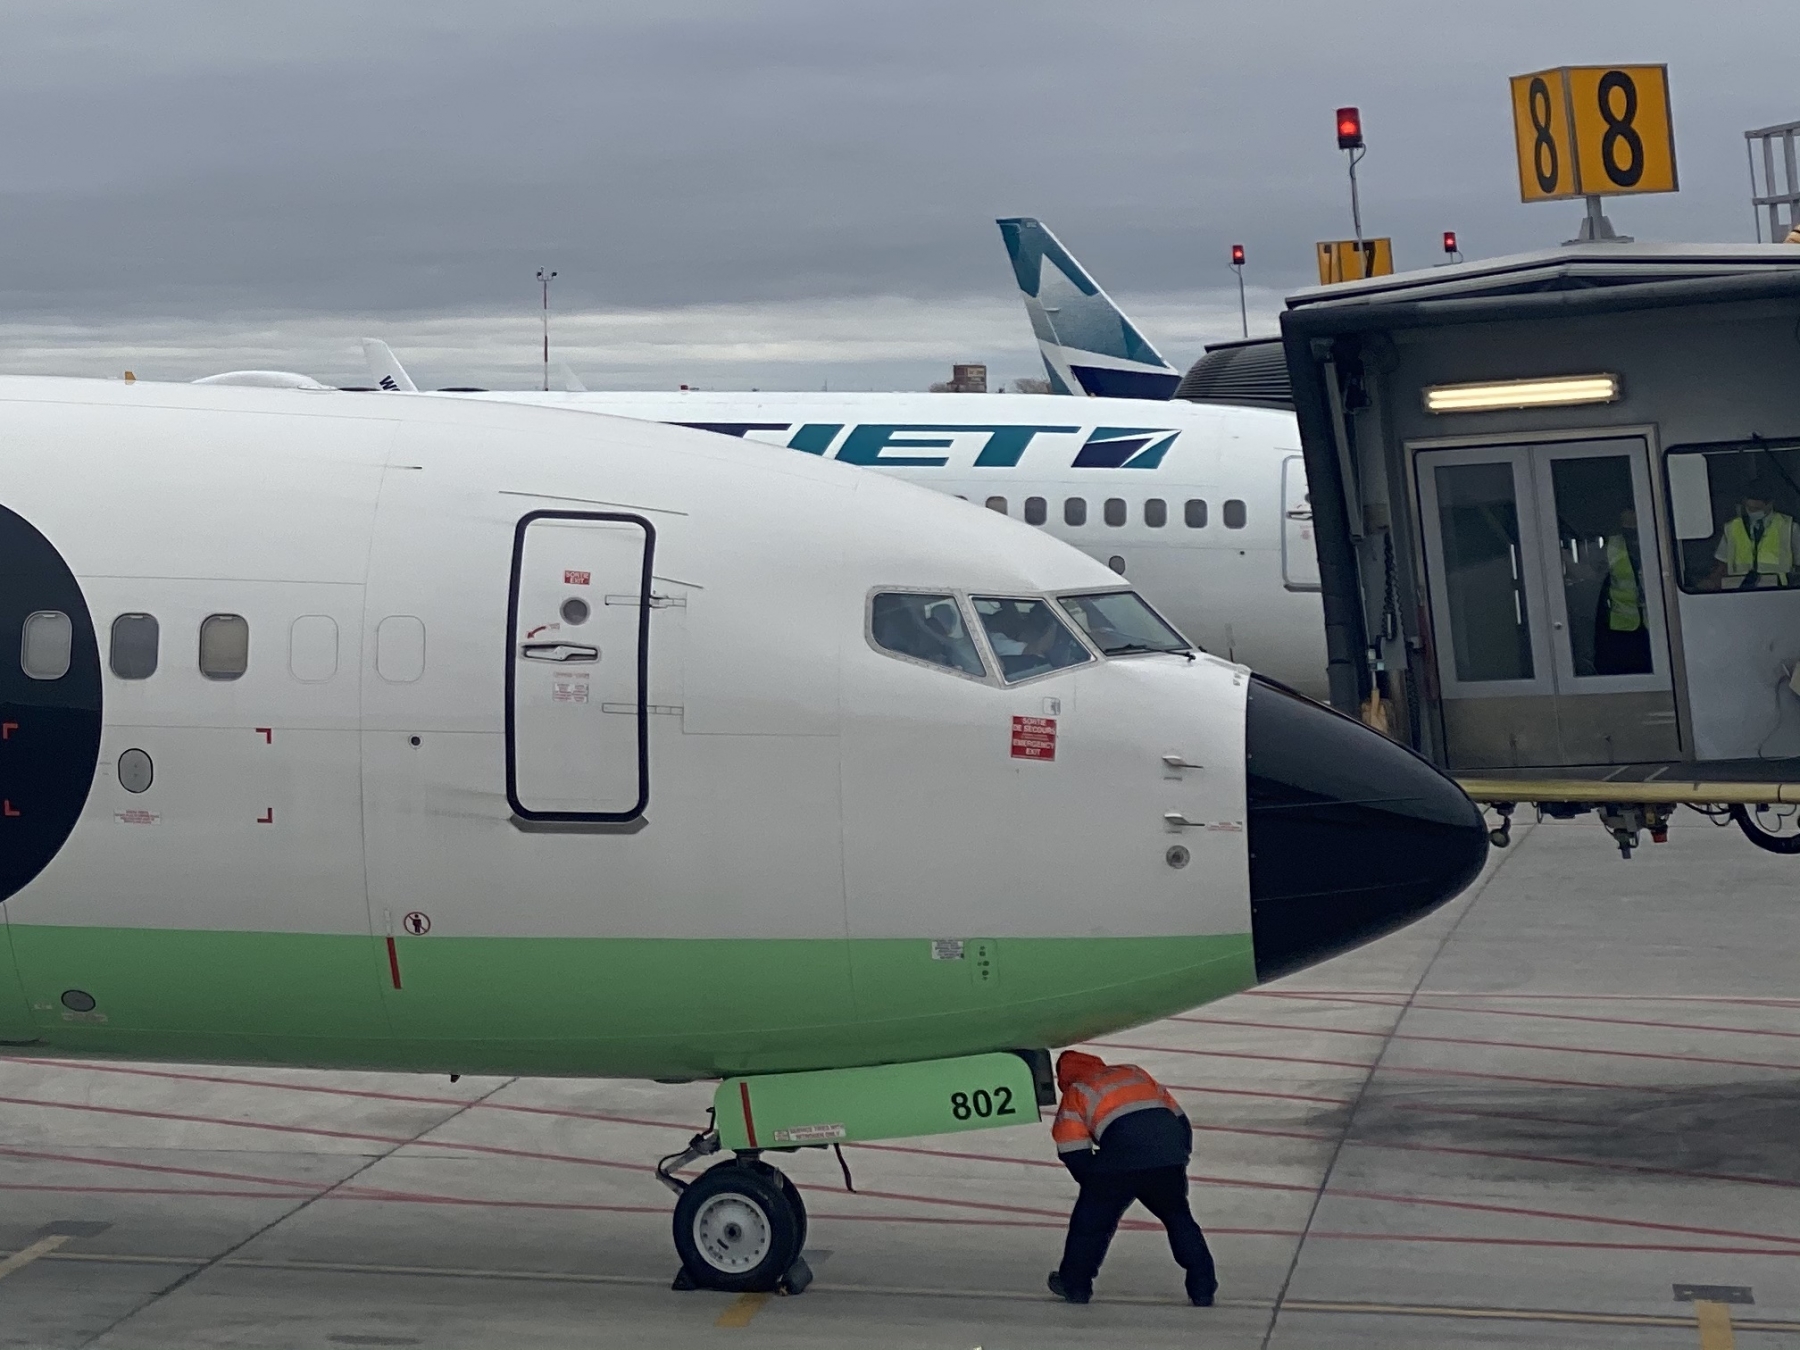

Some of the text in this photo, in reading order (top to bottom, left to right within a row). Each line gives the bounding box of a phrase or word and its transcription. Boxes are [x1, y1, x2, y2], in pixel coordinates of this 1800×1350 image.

[1529, 78, 1559, 194] 8
[1597, 70, 1644, 187] 8
[1353, 241, 1376, 278] 7
[1013, 739, 1055, 749] EMERGENCY
[1023, 725, 1056, 735] SECOURS
[1026, 747, 1041, 756] EXIT
[950, 1086, 1016, 1121] 802
